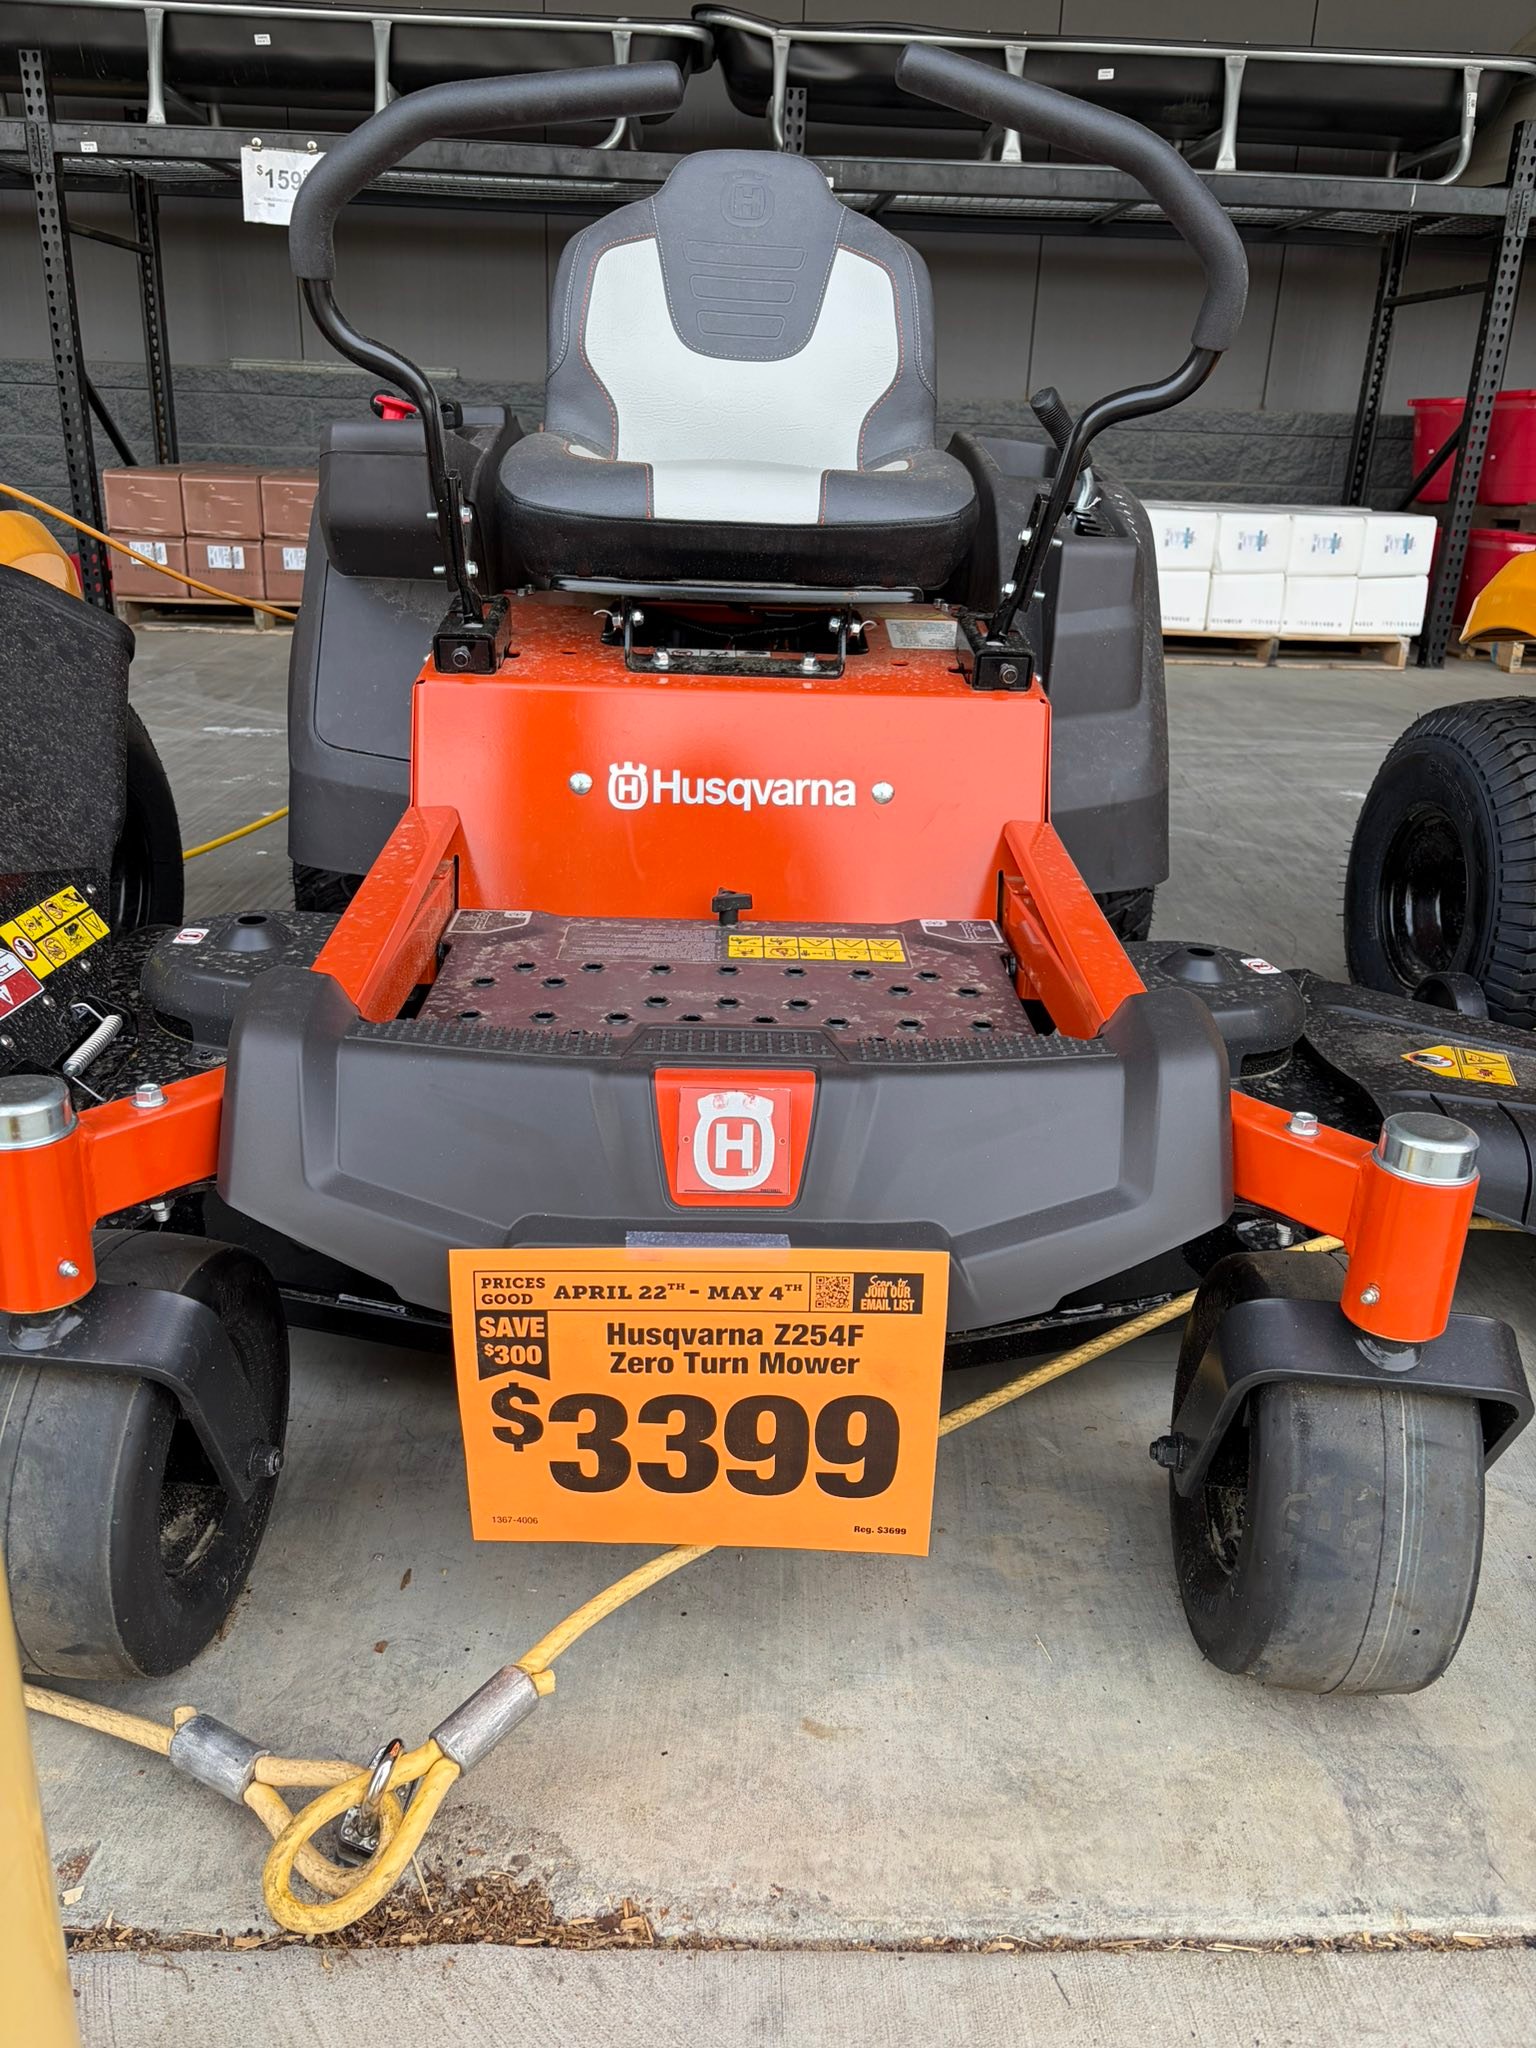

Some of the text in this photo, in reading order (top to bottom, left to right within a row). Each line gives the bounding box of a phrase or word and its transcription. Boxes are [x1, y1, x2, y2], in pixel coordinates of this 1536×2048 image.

[653, 769, 857, 811] Husqvarna
[481, 1277, 546, 1289] PRICES
[869, 1275, 909, 1288] Scan to
[481, 1293, 534, 1305] GOOD
[553, 1285, 632, 1300] APRIL
[707, 1286, 763, 1301] MAY
[769, 1283, 803, 1301] 4TH
[864, 1286, 911, 1299] JOIN OUR
[860, 1299, 915, 1311] EMAIL LIST
[479, 1316, 546, 1338] SAVE
[606, 1322, 865, 1351] Husqvarna Z254F
[483, 1343, 543, 1365] $300
[610, 1351, 861, 1375] Zero Turn Mower
[491, 1382, 901, 1499] $3399
[492, 1516, 539, 1525] 1367-4006
[853, 1525, 907, 1535] Reg. $3699
